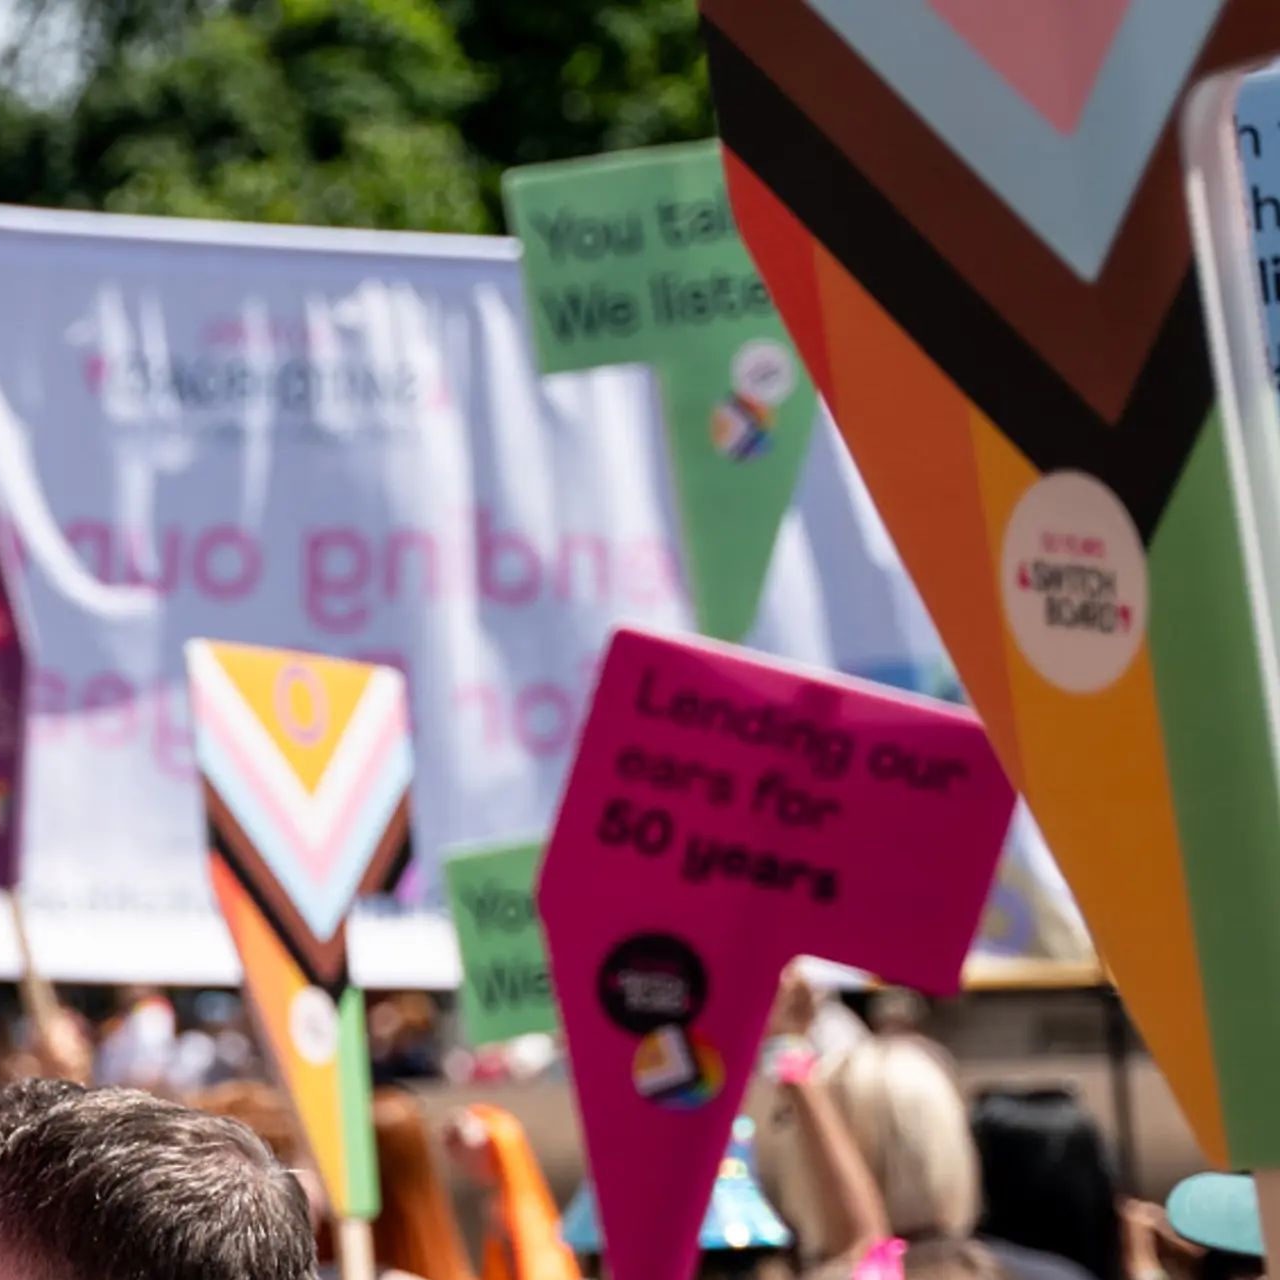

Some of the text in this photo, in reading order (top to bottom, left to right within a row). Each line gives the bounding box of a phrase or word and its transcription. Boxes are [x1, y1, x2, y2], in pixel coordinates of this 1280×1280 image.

[530, 207, 645, 264] You
[541, 284, 642, 345] We
[634, 668, 970, 790] Lending our
[613, 745, 843, 827] ears for
[596, 797, 838, 904] 50 years
